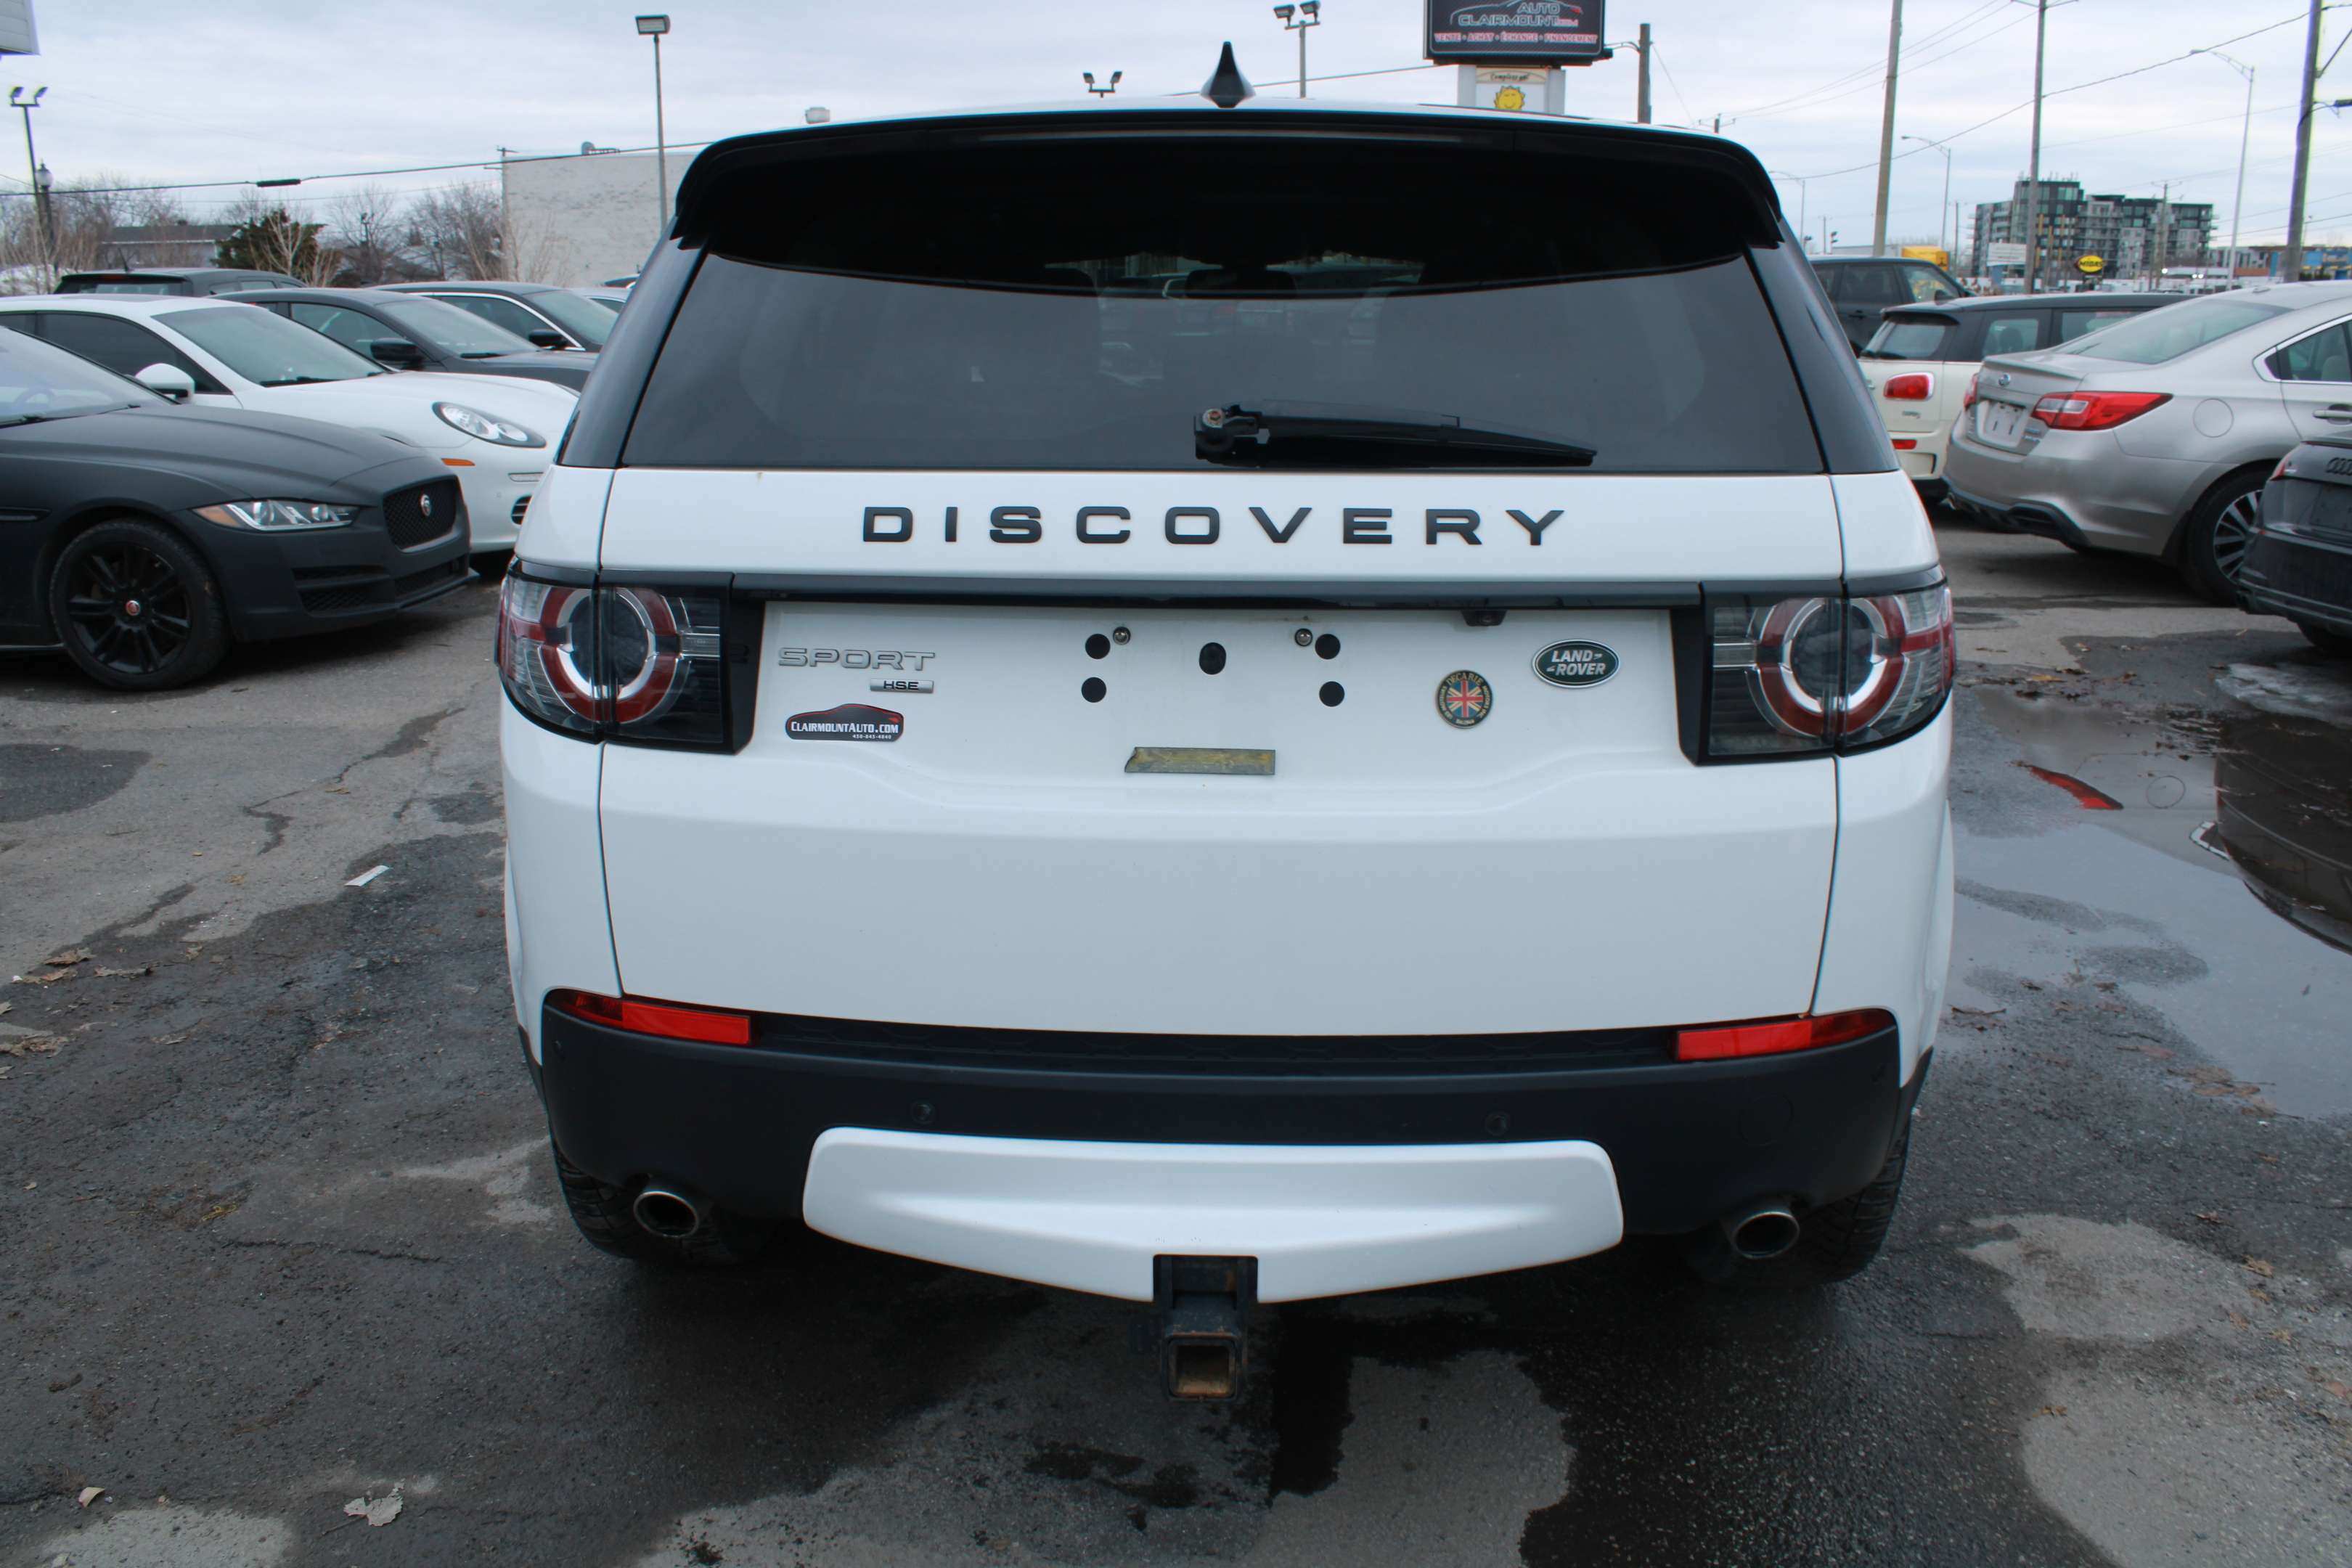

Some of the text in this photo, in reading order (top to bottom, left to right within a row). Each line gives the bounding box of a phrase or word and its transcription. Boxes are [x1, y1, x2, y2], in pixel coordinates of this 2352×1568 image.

[1517, 3, 1560, 15] AUTO
[1458, 15, 1559, 27] CLAIRMOUNT
[1434, 33, 1462, 43] VENTE
[1467, 33, 1494, 43] ACHAT
[1544, 33, 1597, 44] FINANCEMENT
[862, 506, 1564, 546] DISCOVERY
[778, 647, 936, 671] SPORT
[1551, 650, 1593, 662] LAND
[1555, 663, 1606, 676] ROVER
[883, 680, 920, 690] HSE
[1445, 672, 1484, 686] DECARIE
